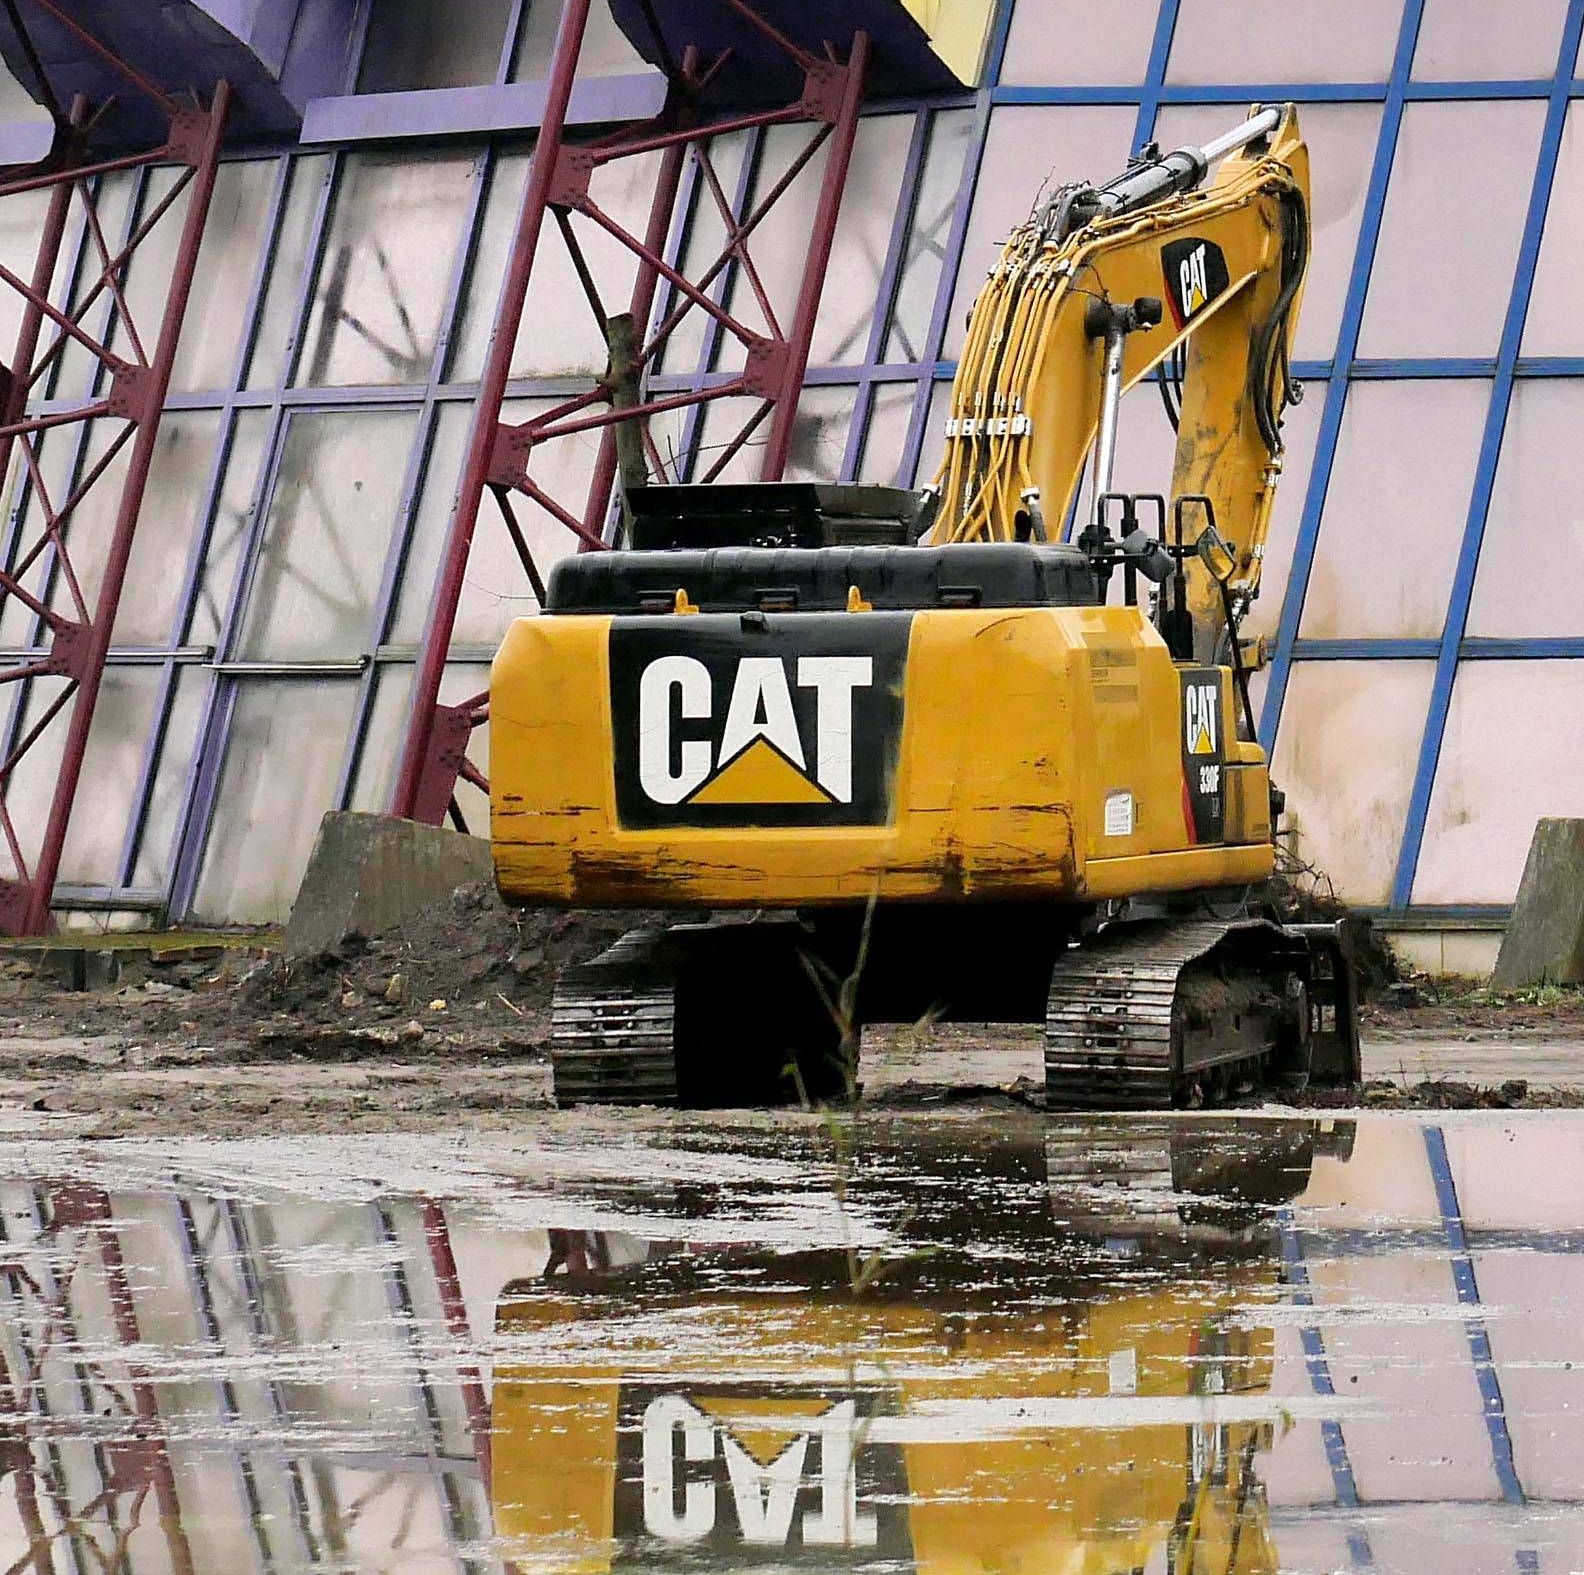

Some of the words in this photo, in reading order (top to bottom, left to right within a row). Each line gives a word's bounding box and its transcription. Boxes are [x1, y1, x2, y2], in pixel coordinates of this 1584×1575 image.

[1180, 243, 1208, 317] CAT
[639, 655, 873, 804] CAT
[1186, 685, 1217, 755] CAT
